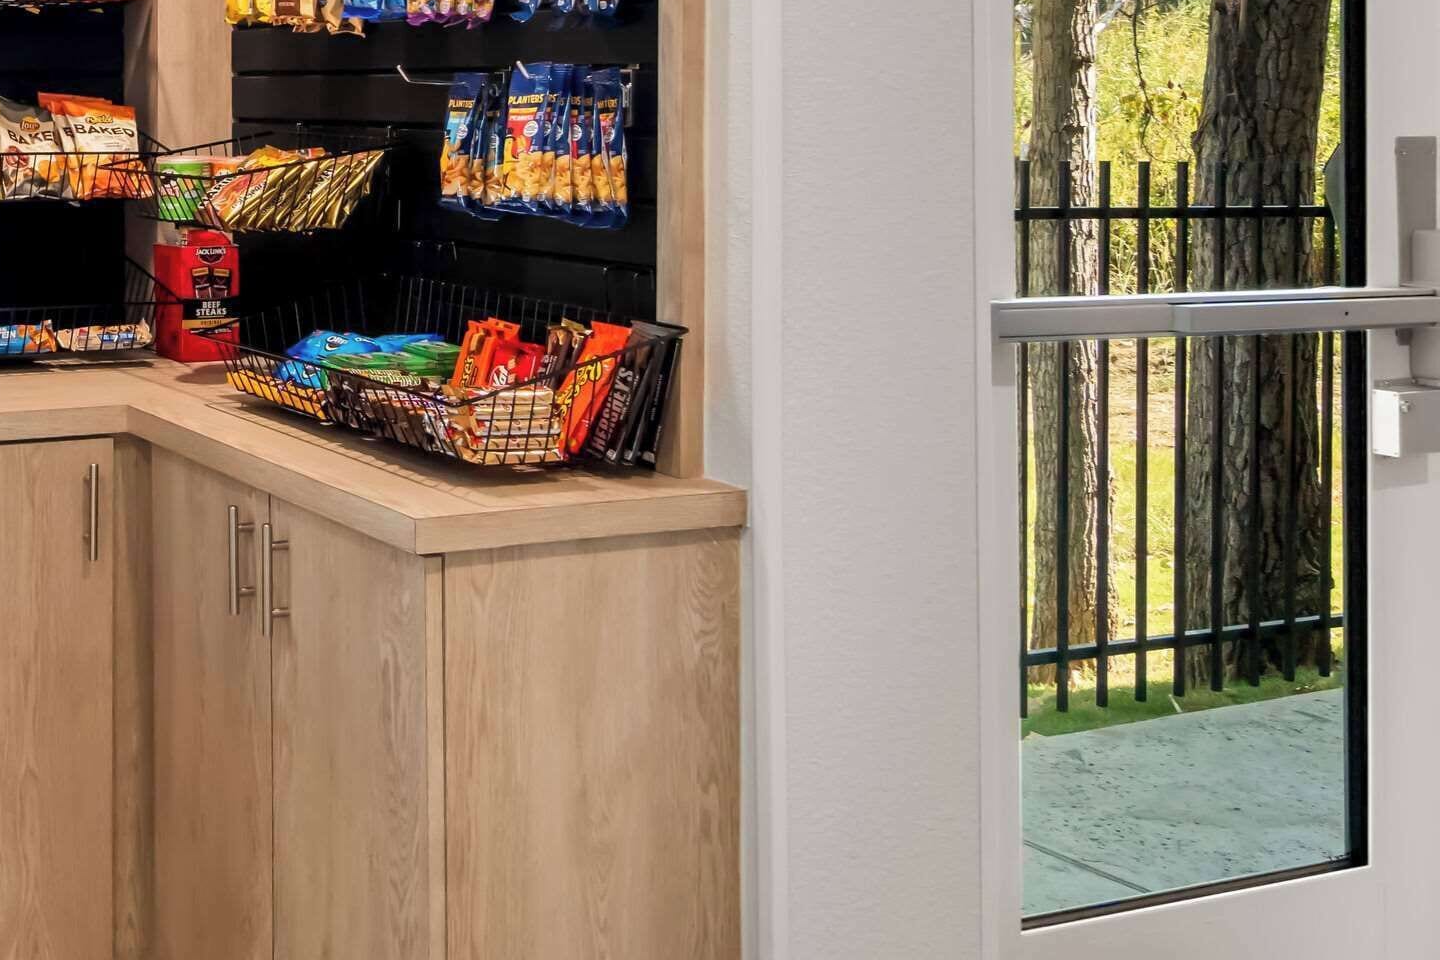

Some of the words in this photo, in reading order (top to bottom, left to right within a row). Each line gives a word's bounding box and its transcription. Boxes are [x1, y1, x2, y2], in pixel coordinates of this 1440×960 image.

[508, 94, 545, 106] PLANTERS
[75, 124, 136, 138] BAKED
[202, 301, 221, 309] BEEF
[195, 308, 227, 317] STEAKS
